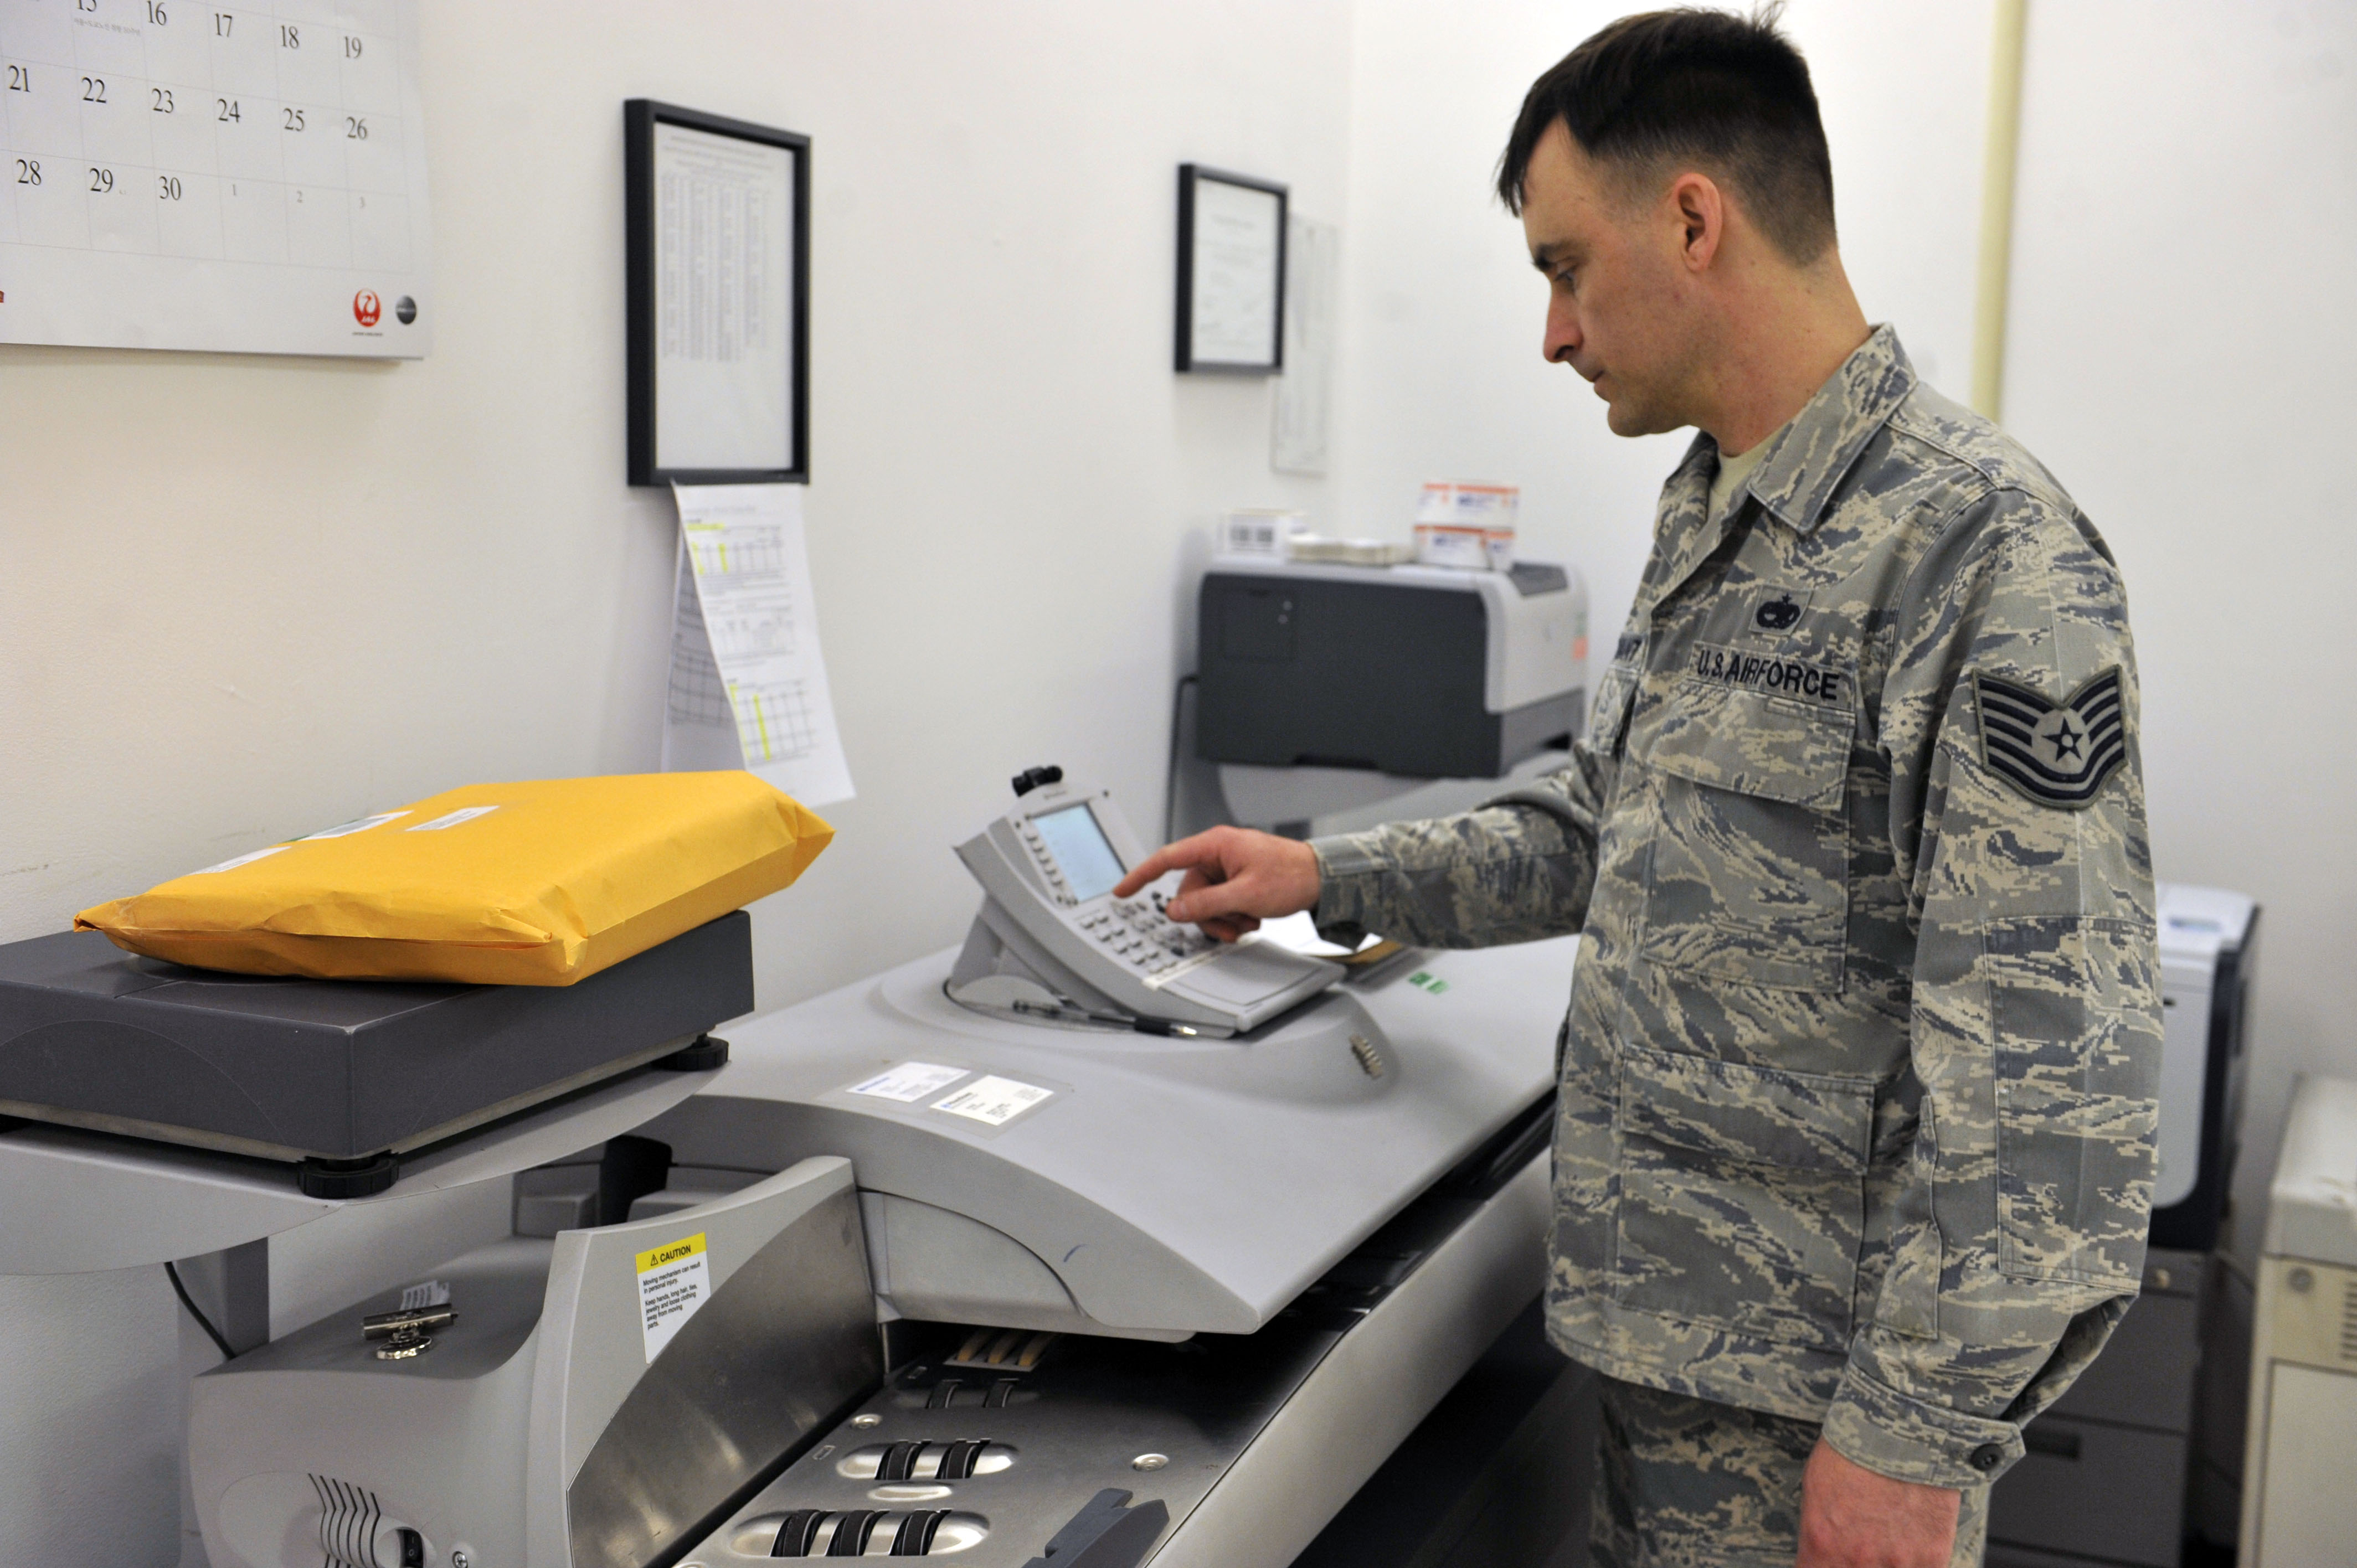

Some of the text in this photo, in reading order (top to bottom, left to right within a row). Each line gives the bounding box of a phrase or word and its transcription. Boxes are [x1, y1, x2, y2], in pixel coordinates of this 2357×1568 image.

[147, 0, 363, 59] 16 17 18 19
[8, 65, 368, 141] 21 22 23 24 25 26
[16, 158, 43, 187] 28
[90, 167, 114, 194] 29
[159, 176, 182, 202] 30
[232, 184, 238, 198] 1
[296, 190, 303, 205] 2
[1697, 649, 1724, 679] U.S.
[660, 1245, 691, 1262] CAUTION
[643, 1277, 658, 1286] Moving
[659, 1269, 681, 1281] mechanism
[690, 1261, 701, 1270] result
[649, 1281, 666, 1293] personal
[646, 1305, 660, 1316] jewelry
[680, 1292, 696, 1301] clothing
[668, 1304, 683, 1313] moving
[647, 1322, 659, 1331] parts.
